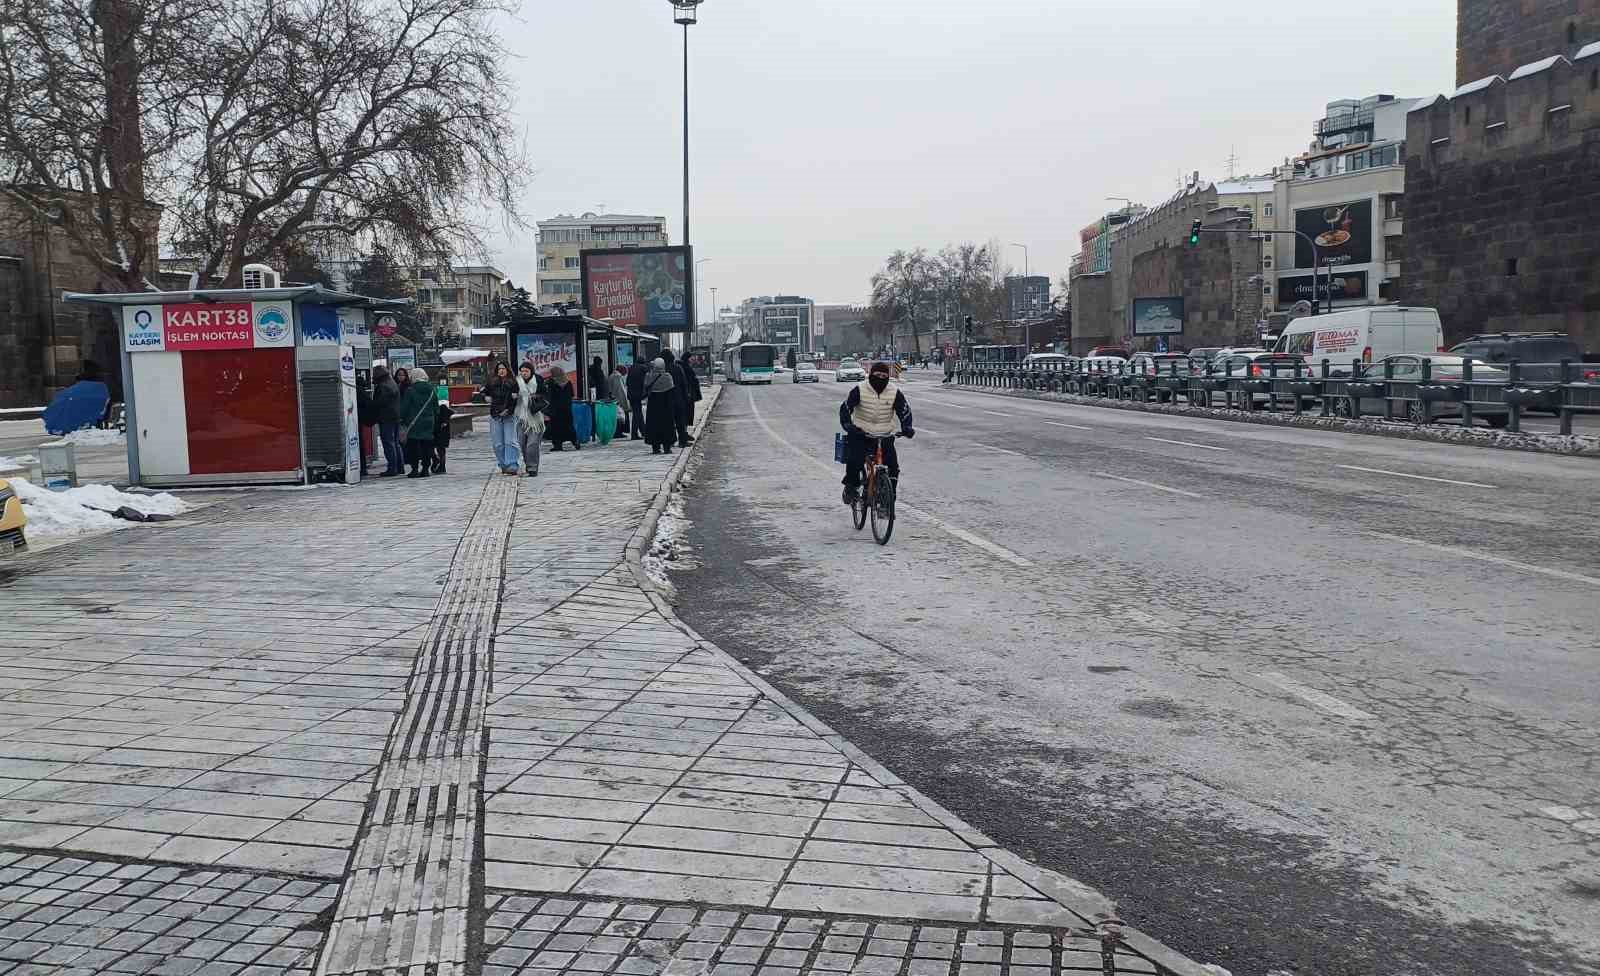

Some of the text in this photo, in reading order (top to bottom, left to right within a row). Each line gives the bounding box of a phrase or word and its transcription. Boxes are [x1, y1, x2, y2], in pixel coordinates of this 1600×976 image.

[167, 309, 249, 327] KART38
[168, 331, 249, 343] İŞLEM NOKTASI
